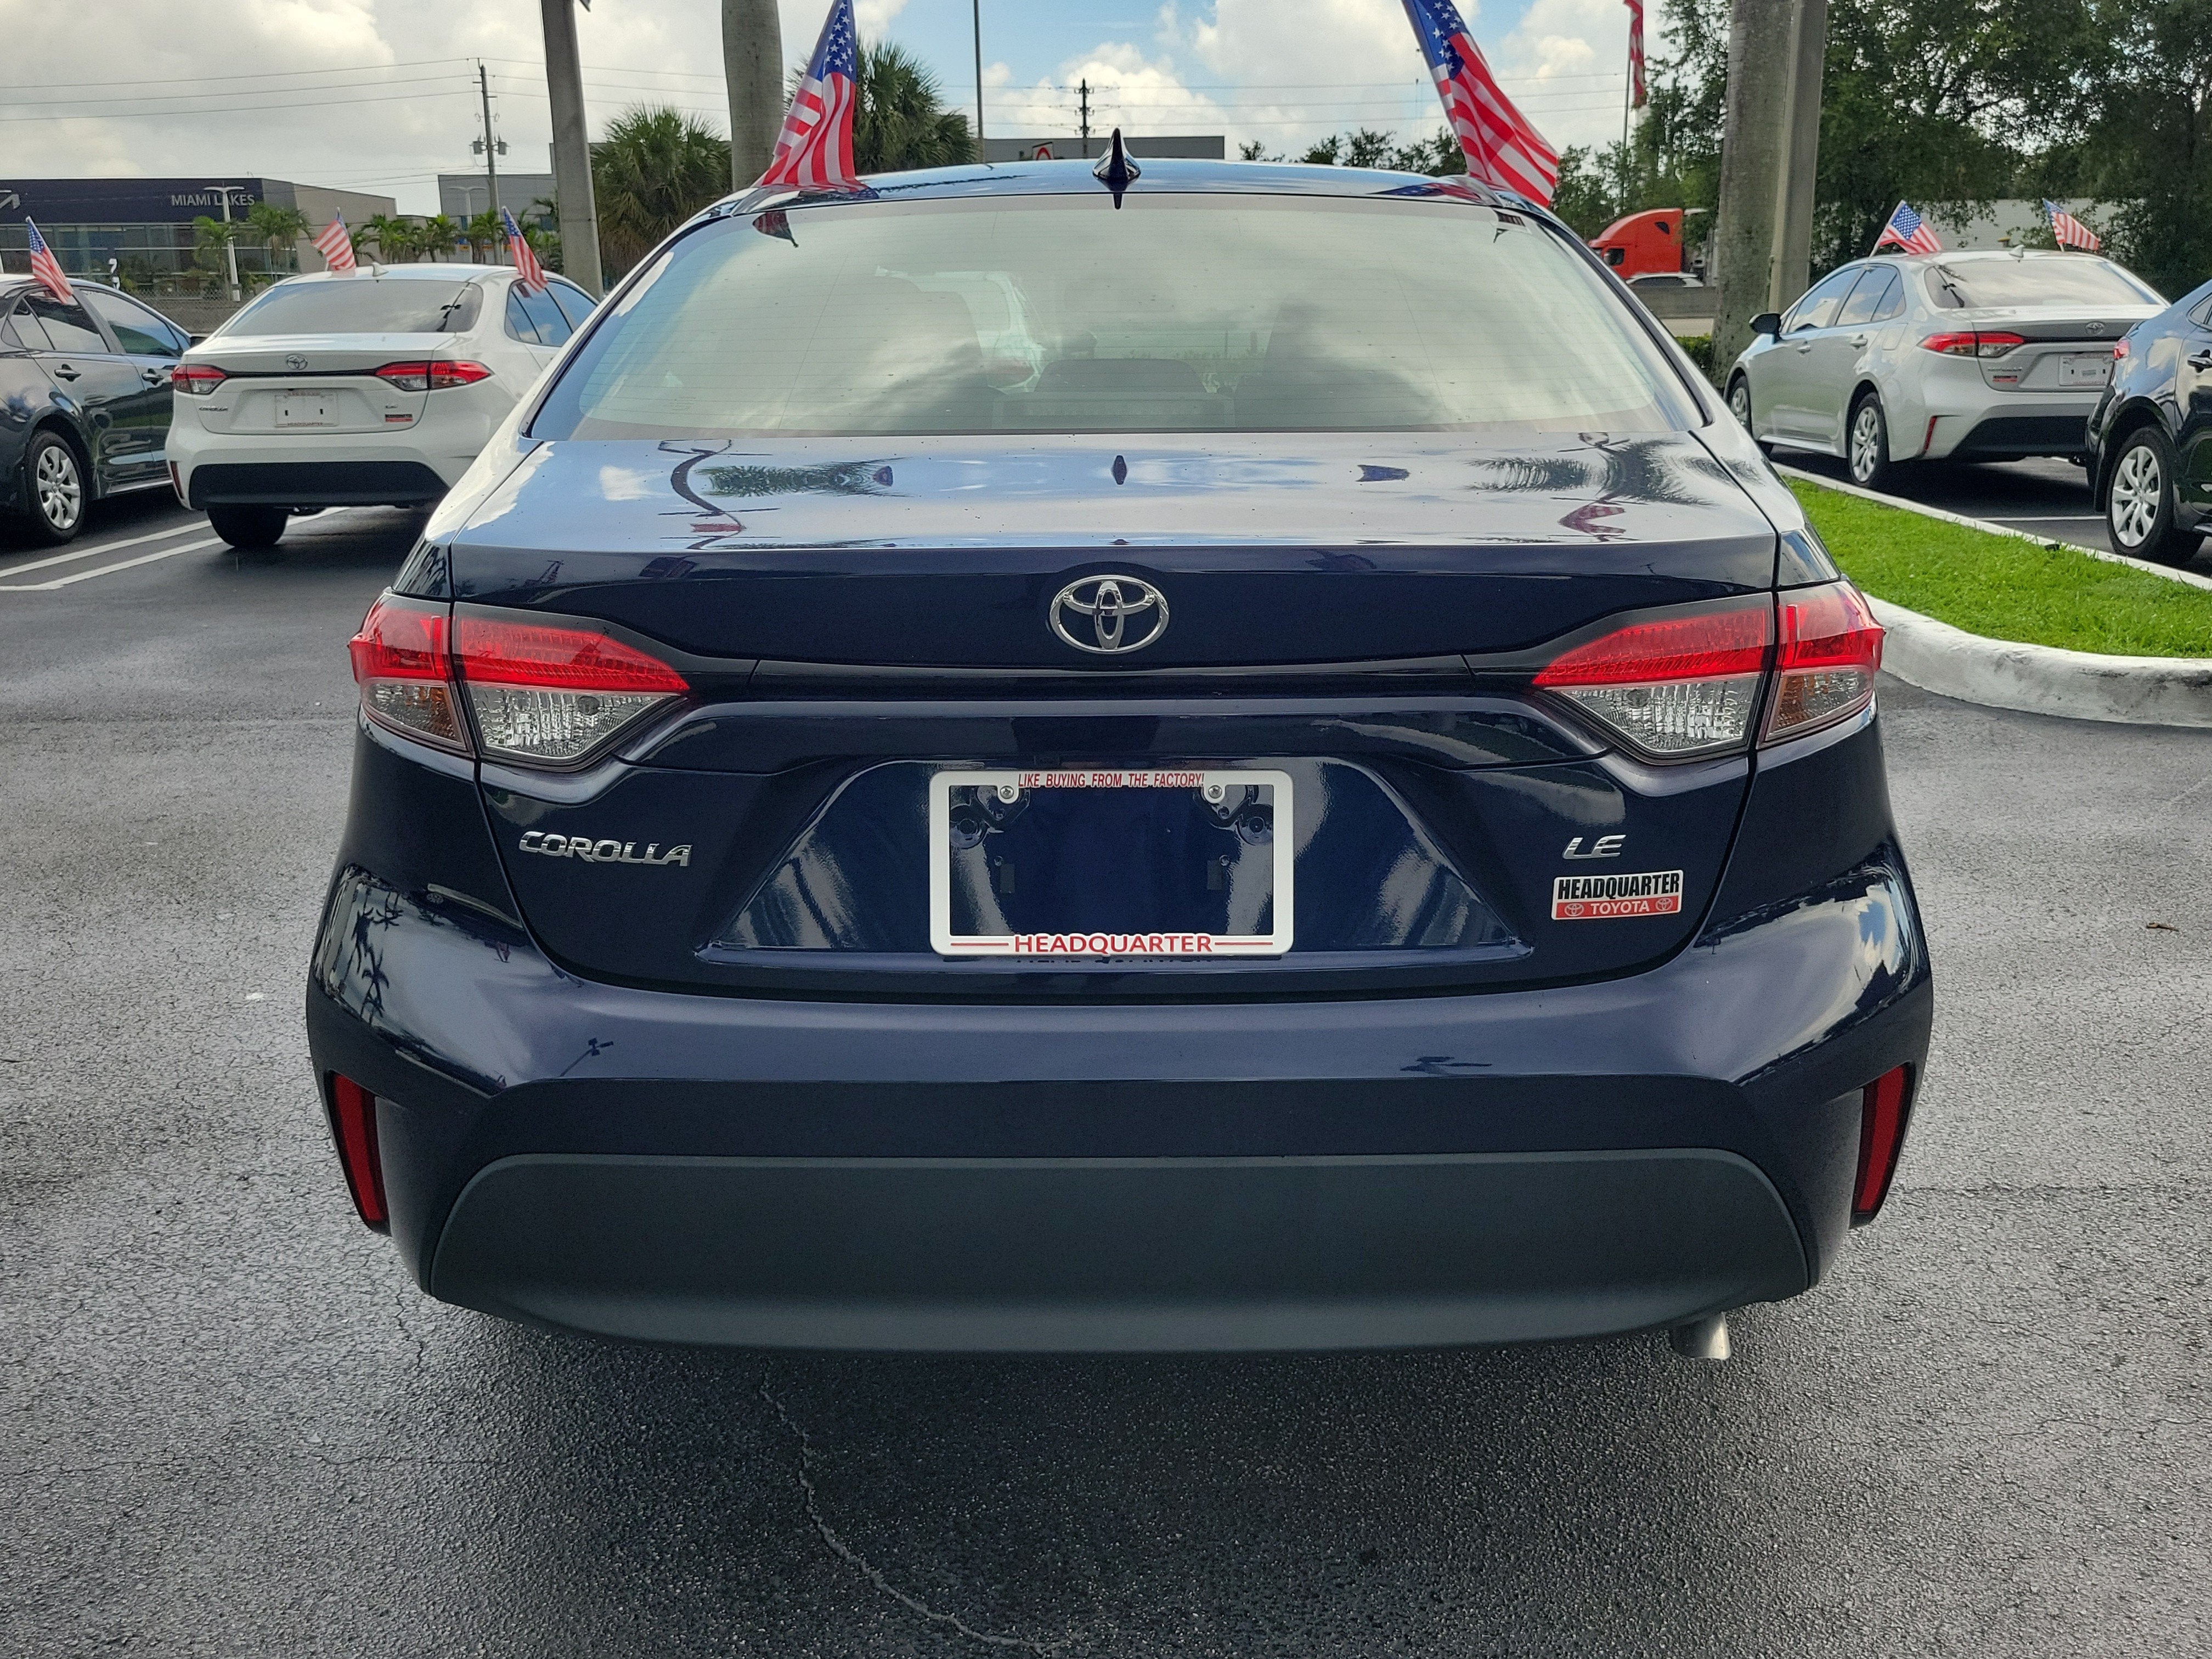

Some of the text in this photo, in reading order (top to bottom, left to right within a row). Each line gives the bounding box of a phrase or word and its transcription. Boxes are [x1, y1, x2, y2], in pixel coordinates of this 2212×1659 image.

[171, 194, 255, 206] MIAMI LKES
[1018, 772, 1204, 787] LIKE BUYING FROM THE FACTORY!
[519, 831, 693, 866] COROLLA
[1562, 834, 1626, 859] LE
[1558, 873, 1679, 899] HEADQUARTER
[1590, 900, 1650, 915] TOYOTA
[1015, 935, 1212, 954] HEADQUARTER
